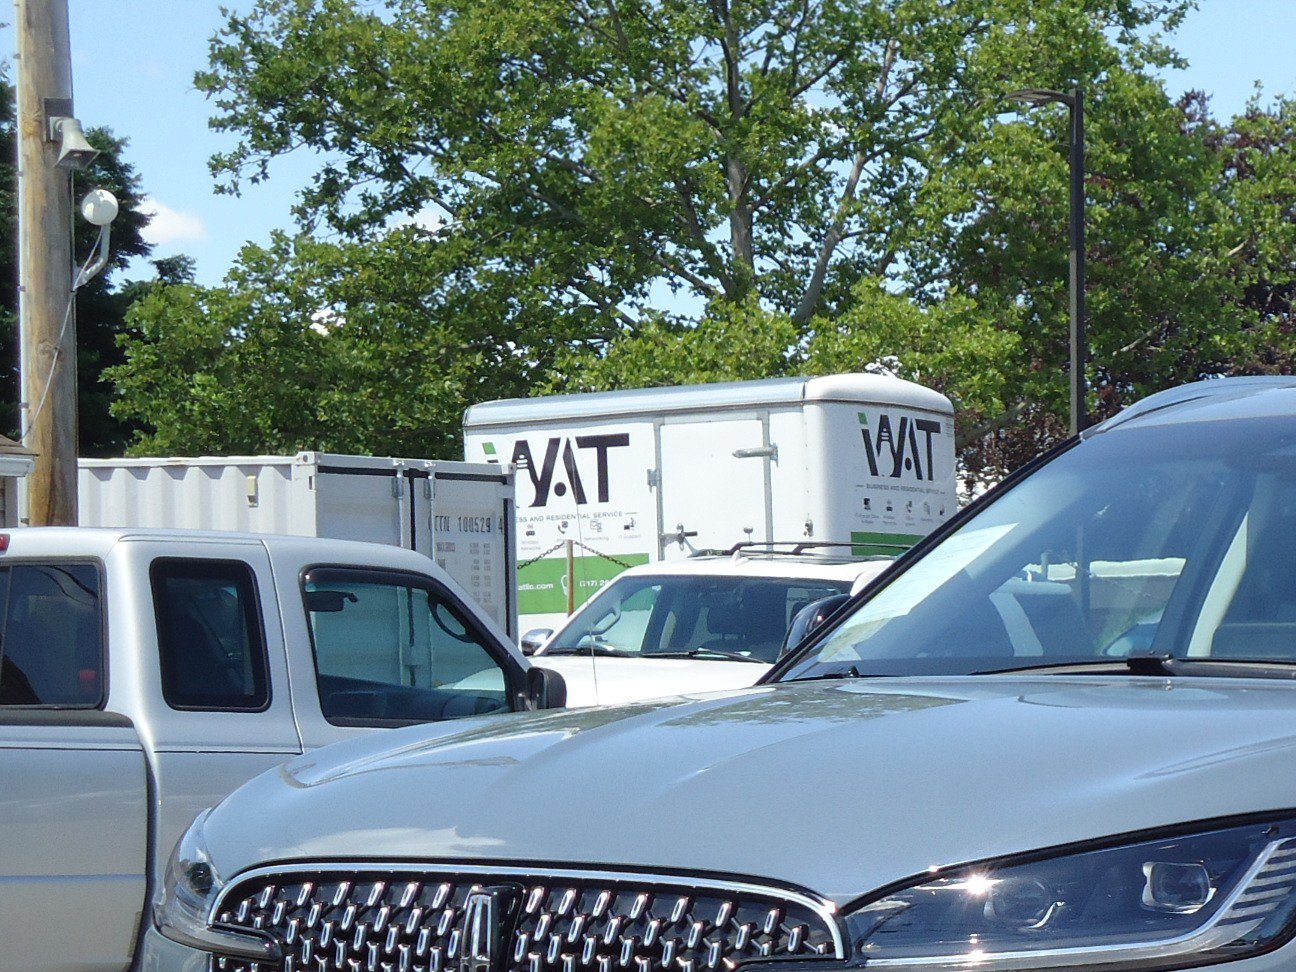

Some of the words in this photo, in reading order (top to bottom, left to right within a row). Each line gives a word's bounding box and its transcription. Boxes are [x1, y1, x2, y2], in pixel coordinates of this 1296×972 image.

[593, 510, 623, 519] SERVICE
[458, 515, 491, 533] 100529
[518, 582, 554, 591] atllc.com
